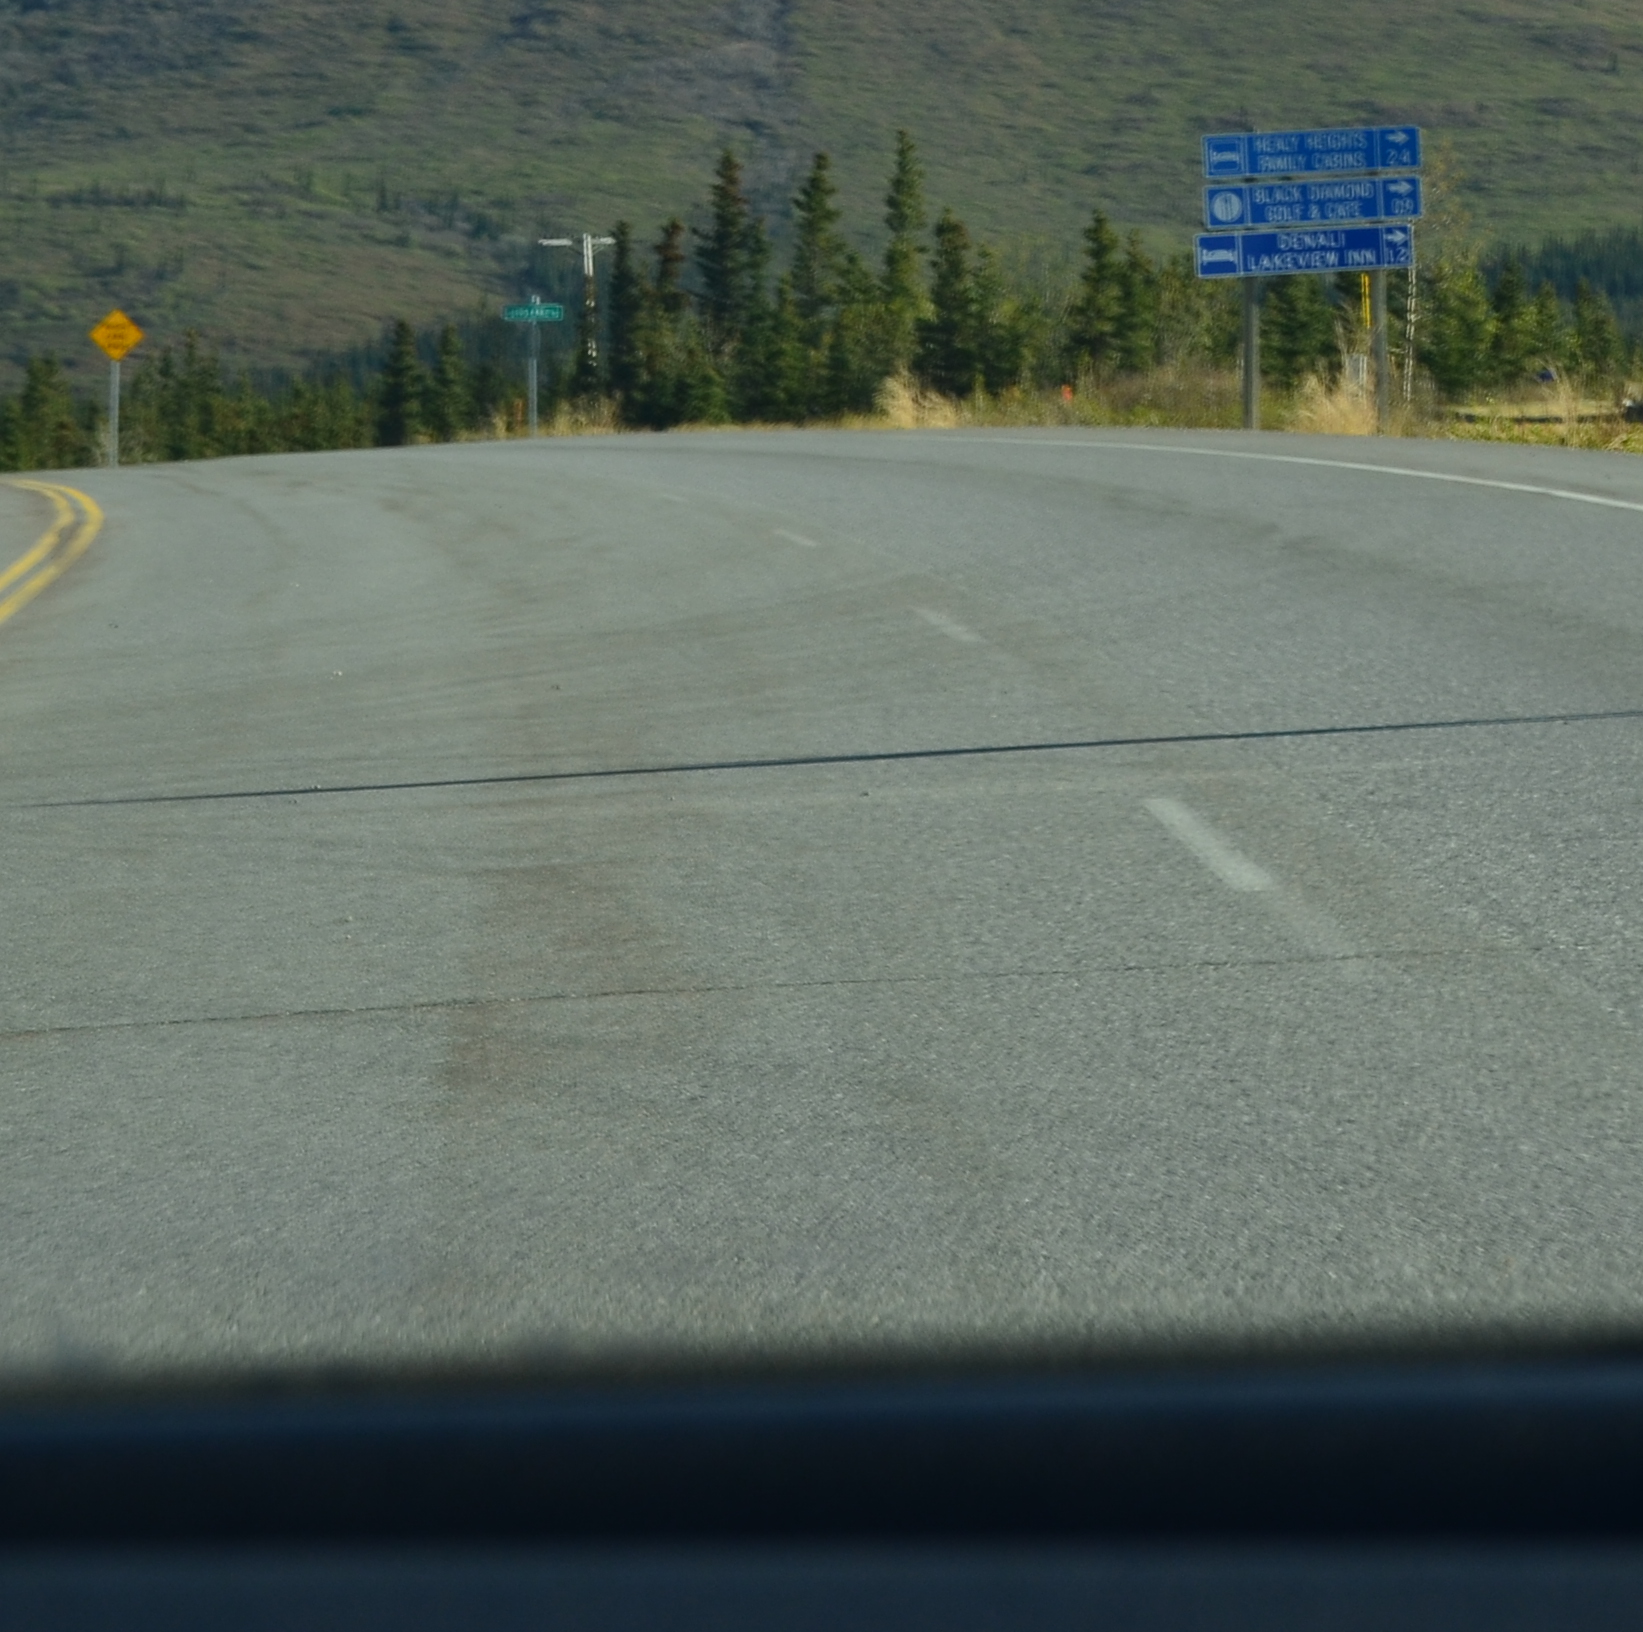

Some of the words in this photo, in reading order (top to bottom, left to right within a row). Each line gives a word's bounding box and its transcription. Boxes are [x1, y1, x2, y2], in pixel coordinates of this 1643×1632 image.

[1254, 137, 1298, 152] HEALY
[1306, 132, 1368, 150] HEIGHTS
[1258, 154, 1306, 172] FAMILY
[1312, 151, 1366, 168] CABINS
[1253, 185, 1302, 204] BLACK
[1308, 182, 1372, 201] DIAMOND
[1265, 205, 1304, 222] GOLF
[1308, 204, 1320, 219] &
[1277, 232, 1346, 250] DENALI
[1247, 251, 1339, 270] LAKEVIEW
[1346, 250, 1377, 265] INN
